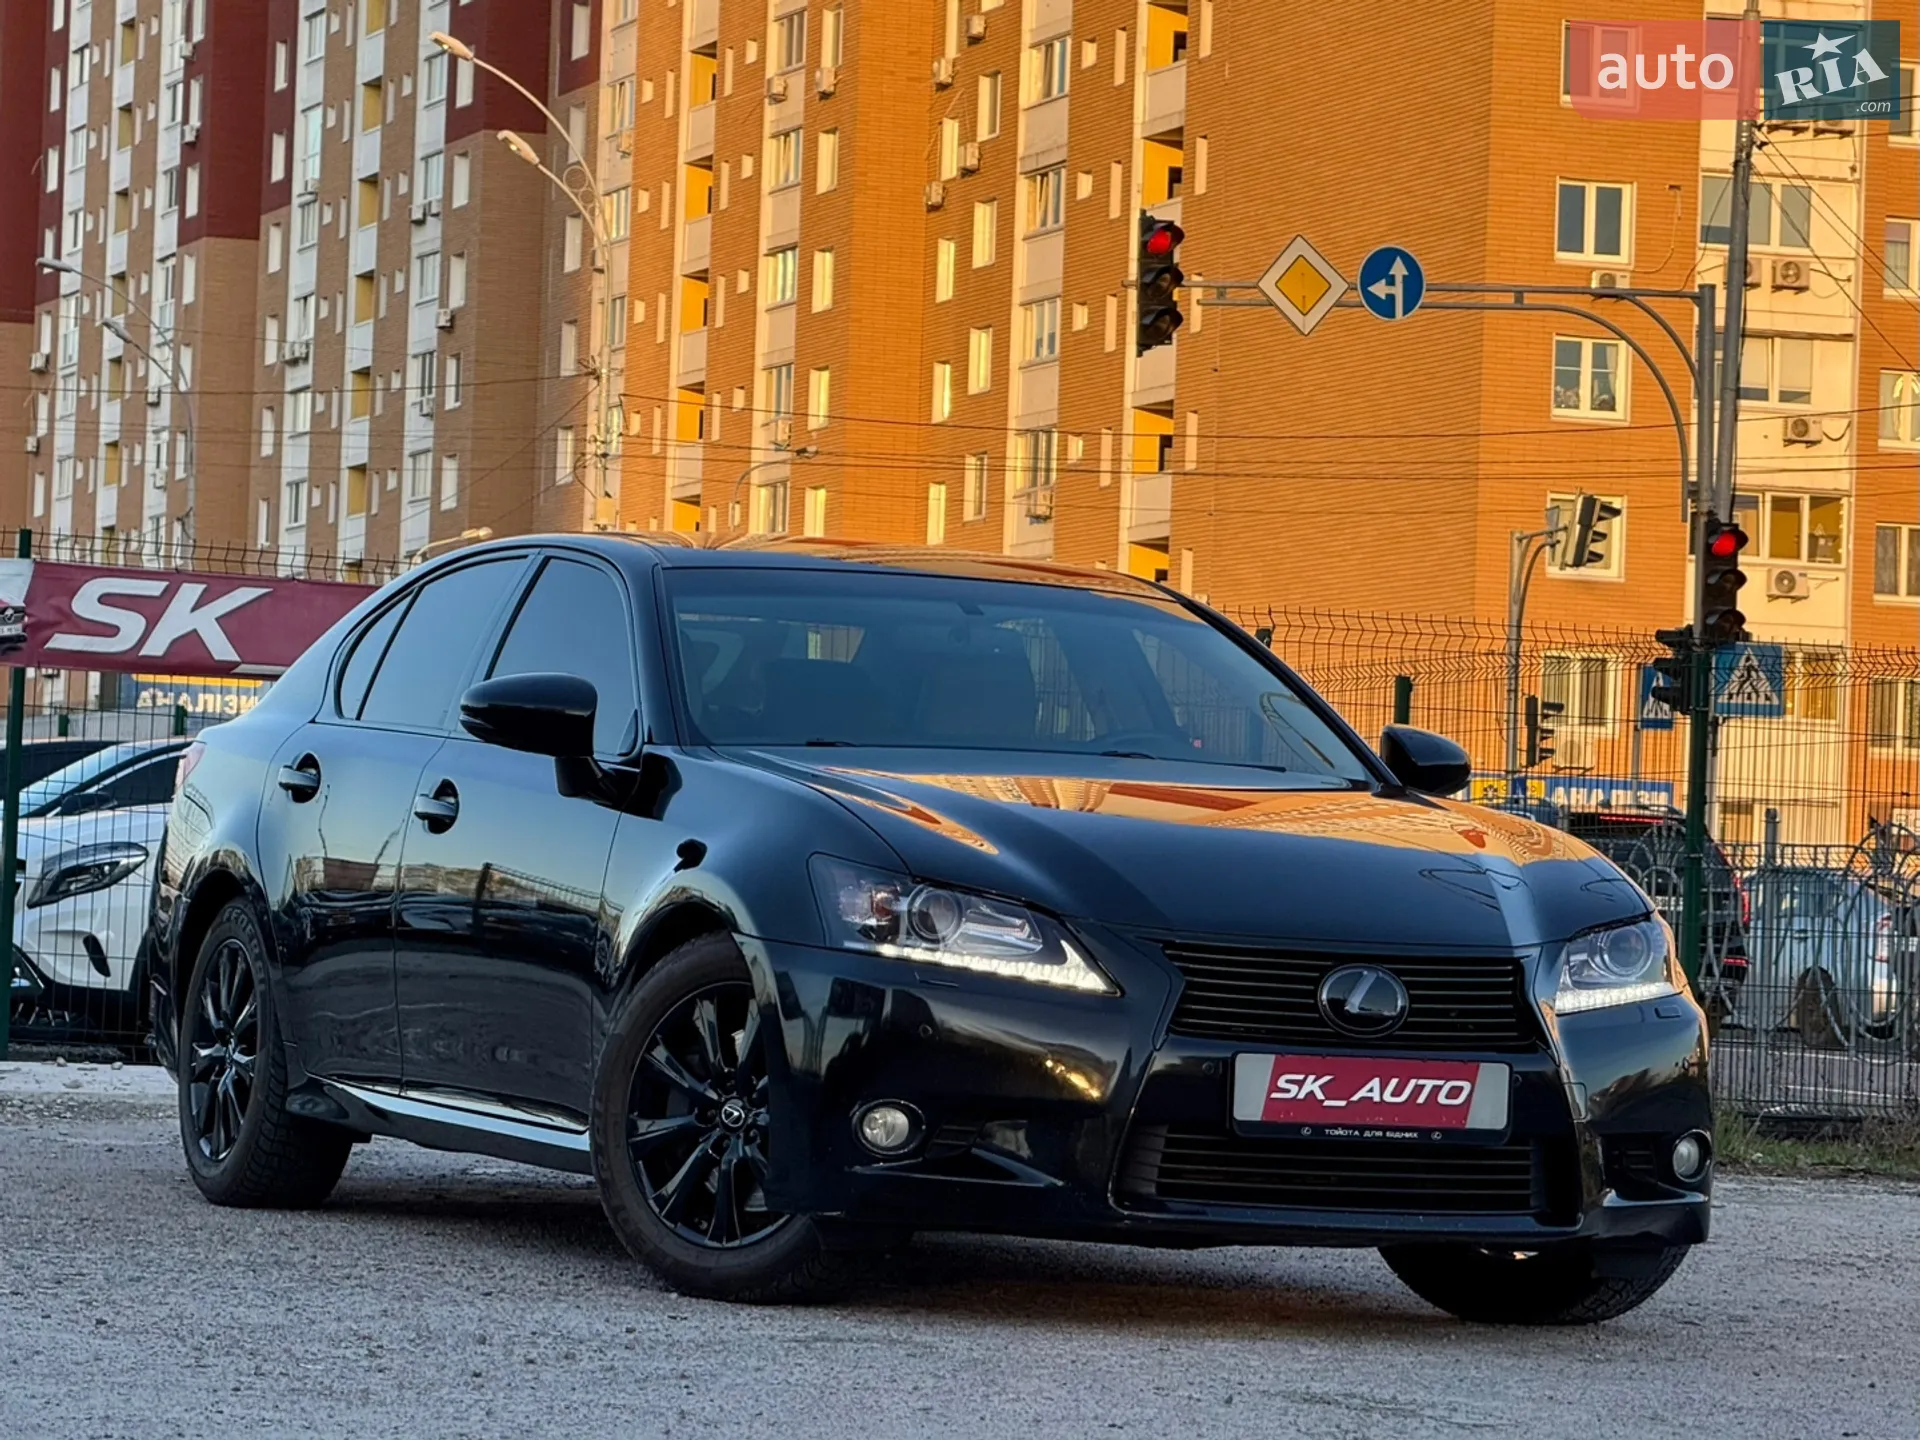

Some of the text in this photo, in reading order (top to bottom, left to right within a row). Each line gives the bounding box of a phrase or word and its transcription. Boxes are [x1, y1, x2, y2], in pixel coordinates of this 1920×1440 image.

[1270, 1074, 1472, 1107] SK_AUTO
[1324, 1127, 1360, 1136] ТОЙОТА
[1363, 1130, 1383, 1139] ДЛЯ
